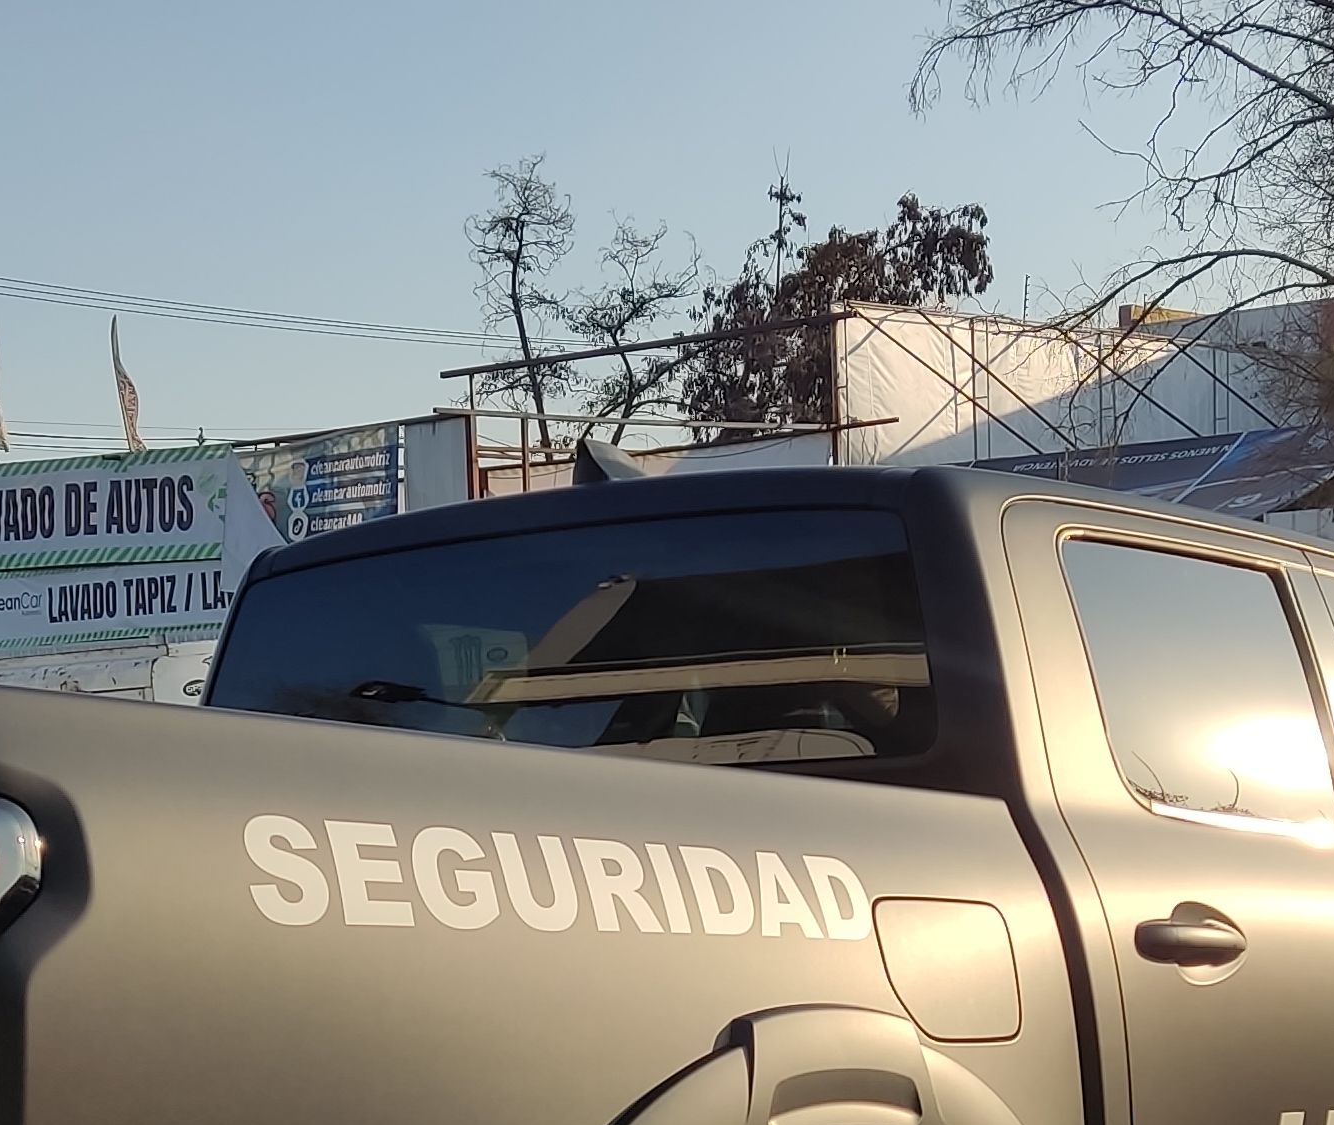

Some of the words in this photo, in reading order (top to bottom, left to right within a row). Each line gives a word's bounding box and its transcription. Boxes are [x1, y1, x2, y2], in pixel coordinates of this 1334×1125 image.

[1120, 452, 1168, 465] SELLOS
[65, 480, 98, 538] DE
[105, 474, 195, 536] AUTOS
[47, 580, 117, 624] LAVADO
[123, 574, 177, 617] TAPIZ
[201, 570, 234, 611] LA
[242, 813, 873, 941] SEGURIDAD
